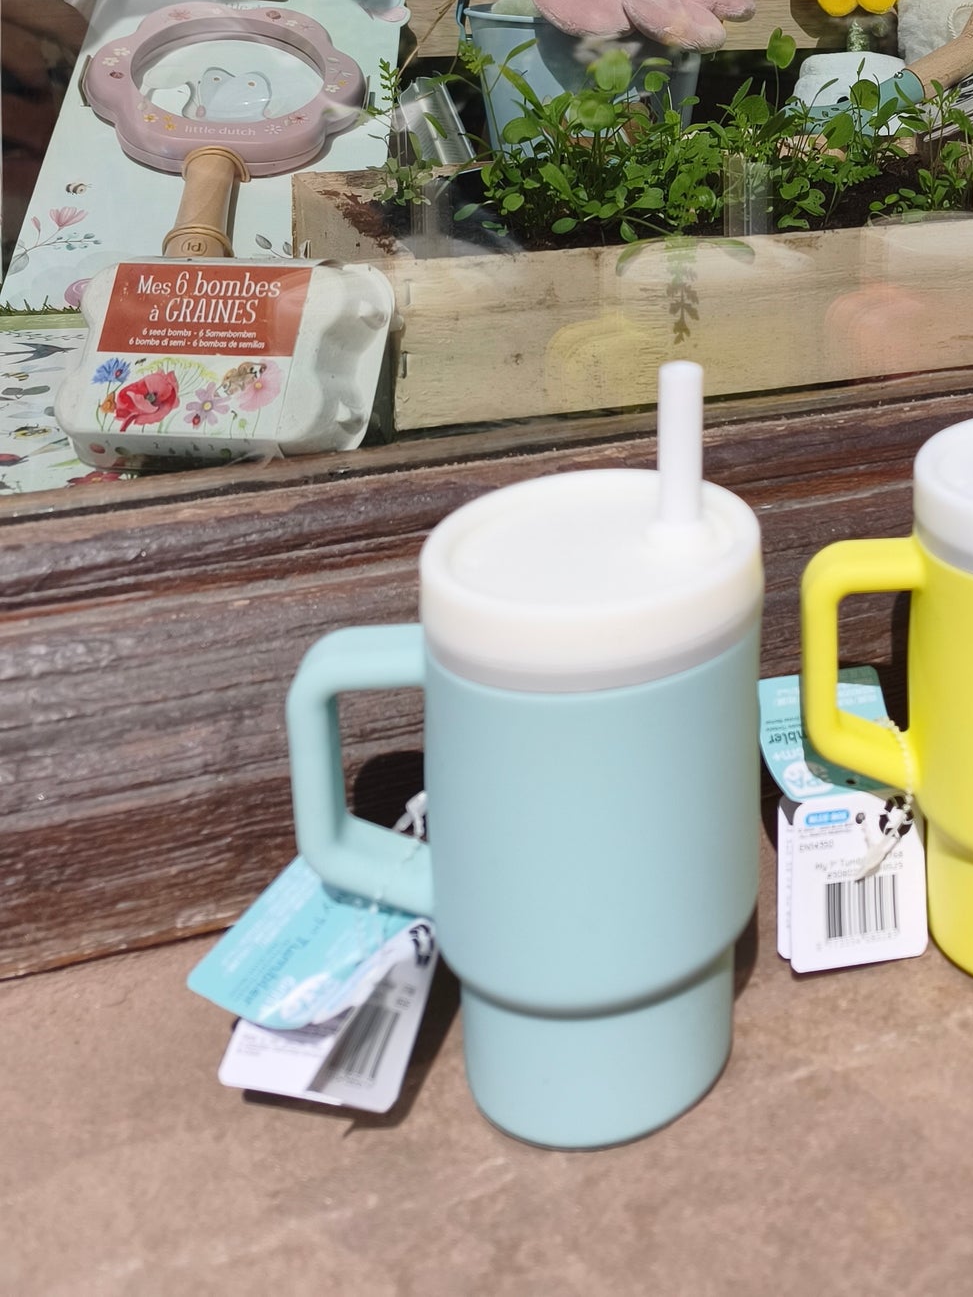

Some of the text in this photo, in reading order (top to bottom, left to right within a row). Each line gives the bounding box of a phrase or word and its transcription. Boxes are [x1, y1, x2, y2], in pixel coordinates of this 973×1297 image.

[185, 125, 256, 136] little dutch
[137, 271, 282, 298] Mes 6 bombes
[149, 298, 259, 324] à GRAINES
[149, 328, 166, 336] seed
[167, 328, 192, 337] bombs
[205, 329, 257, 339] Samenbomben
[135, 338, 160, 347] bombe
[169, 339, 186, 347] semi
[199, 339, 228, 348] bombas
[228, 340, 237, 349] de
[238, 340, 266, 350] semillas
